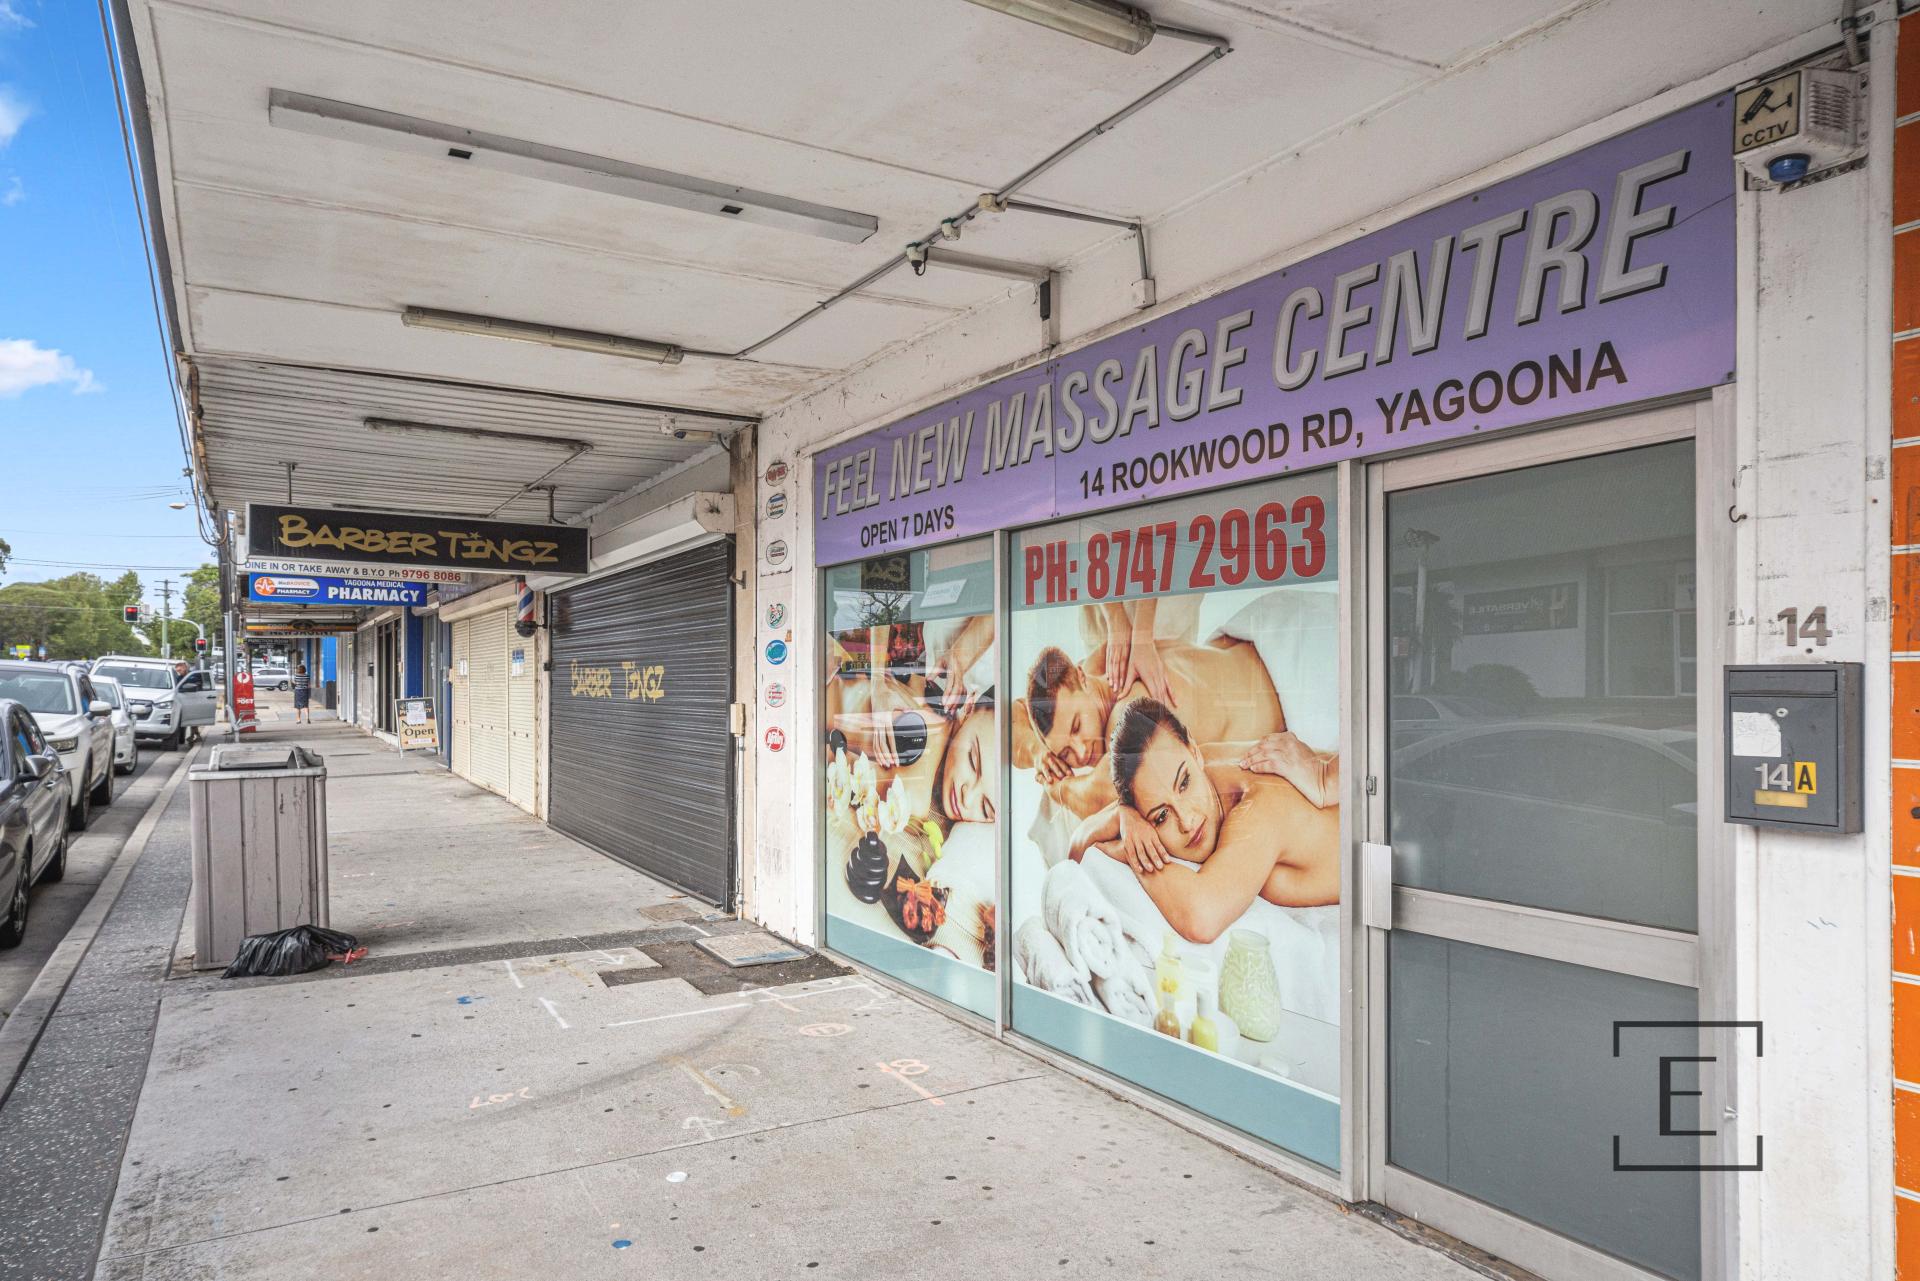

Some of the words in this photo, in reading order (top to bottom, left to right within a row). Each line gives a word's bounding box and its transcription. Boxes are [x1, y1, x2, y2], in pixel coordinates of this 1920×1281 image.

[1741, 120, 1789, 147] CCTV
[822, 447, 881, 520] FEEL
[889, 409, 976, 502] NEW
[982, 308, 1254, 476] MASSAGE
[1271, 147, 1692, 391] CENTRE
[1078, 466, 1105, 500] 14
[1111, 422, 1290, 494] ROOKWOOD
[1301, 406, 1364, 453] RD,
[1375, 340, 1629, 436] YAGOONA
[277, 514, 439, 557] BARBER
[860, 517, 898, 549] OPEN
[901, 515, 909, 540] 7
[913, 504, 956, 538] DAYS
[1023, 539, 1078, 606] PH:
[1086, 520, 1178, 601] 8747
[1188, 494, 1327, 590] 2963
[244, 561, 267, 571] DINE
[269, 562, 279, 571] IN
[281, 563, 296, 572] OR
[298, 564, 323, 573] TAKE
[325, 565, 352, 575] AWAY
[353, 567, 360, 576] &
[388, 569, 400, 577] Ph
[401, 569, 430, 580] 9796
[433, 570, 462, 582] 8086
[344, 579, 376, 588] YAGOONA
[376, 580, 406, 589] MEDICAL
[327, 585, 421, 603] PHARMACY
[1776, 605, 1833, 647] 14
[404, 727, 435, 739] Open
[1754, 762, 1792, 791] 14
[1797, 764, 1815, 791] A
